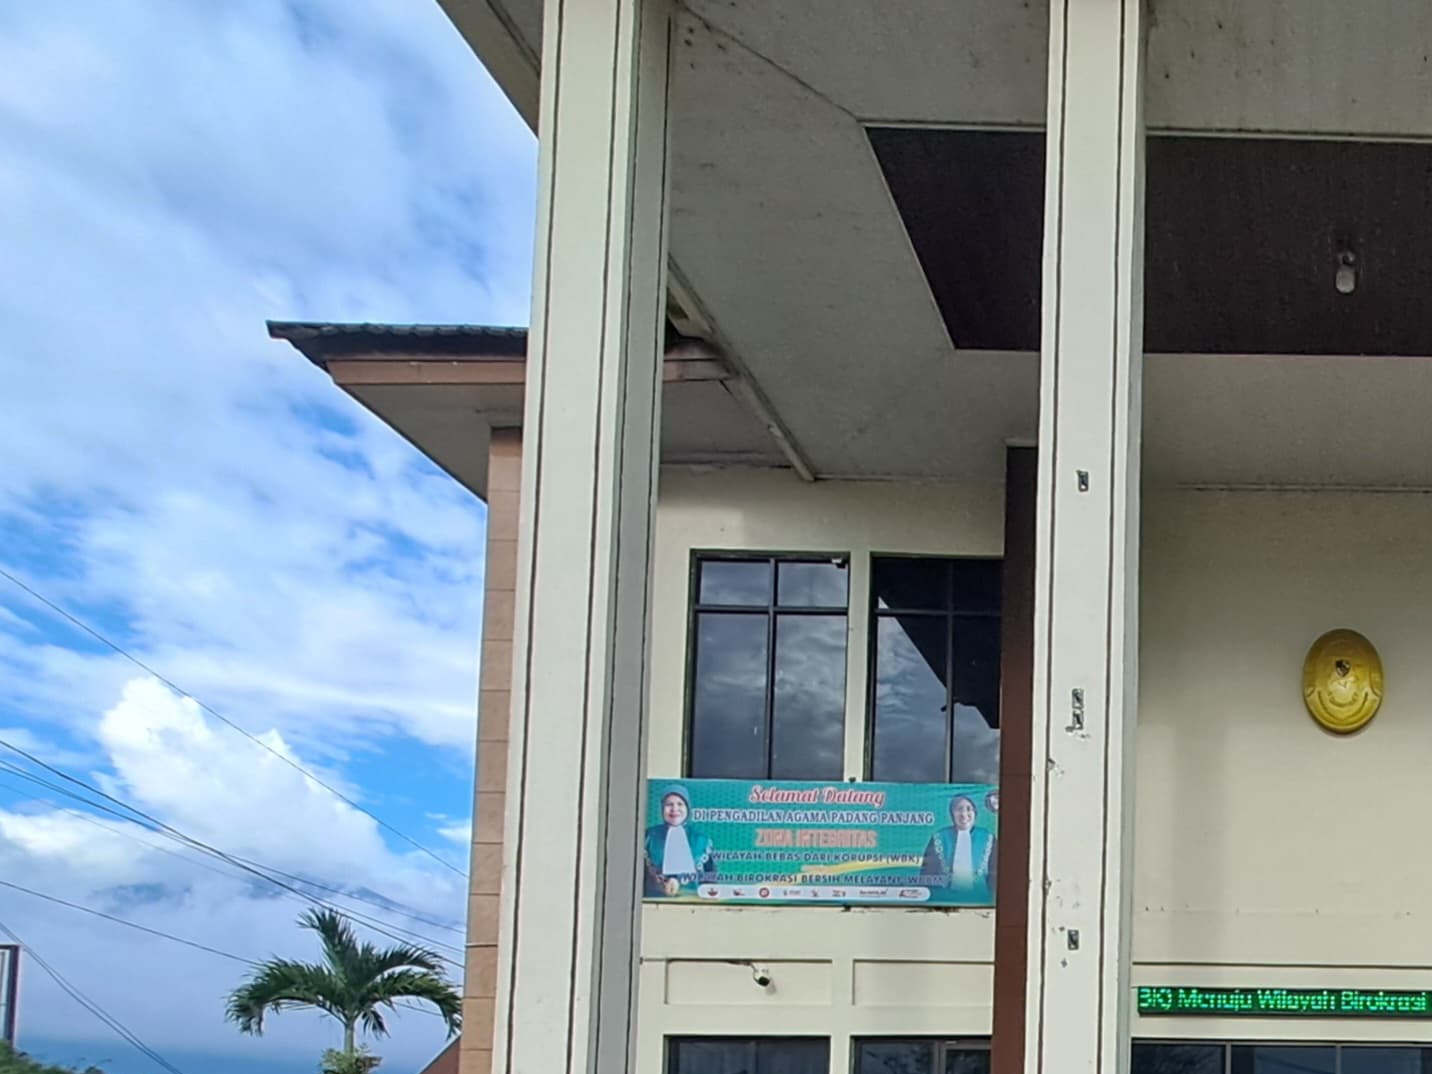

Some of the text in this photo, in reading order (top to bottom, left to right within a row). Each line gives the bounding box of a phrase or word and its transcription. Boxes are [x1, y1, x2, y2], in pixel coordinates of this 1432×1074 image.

[750, 785, 885, 807] Selamat Datang
[693, 810, 933, 825] DI PENGADILAN AGAMA PADANG PANJANG
[712, 851, 920, 864] WILAYAH BEBAS DARI KORUPSI (WBK)
[737, 873, 797, 882] BIROKRASI
[801, 874, 840, 883] BERSIH
[1178, 988, 1252, 1011] Menuju
[1257, 990, 1336, 1010] Wilayah
[1341, 991, 1426, 1011] Birokrasi
